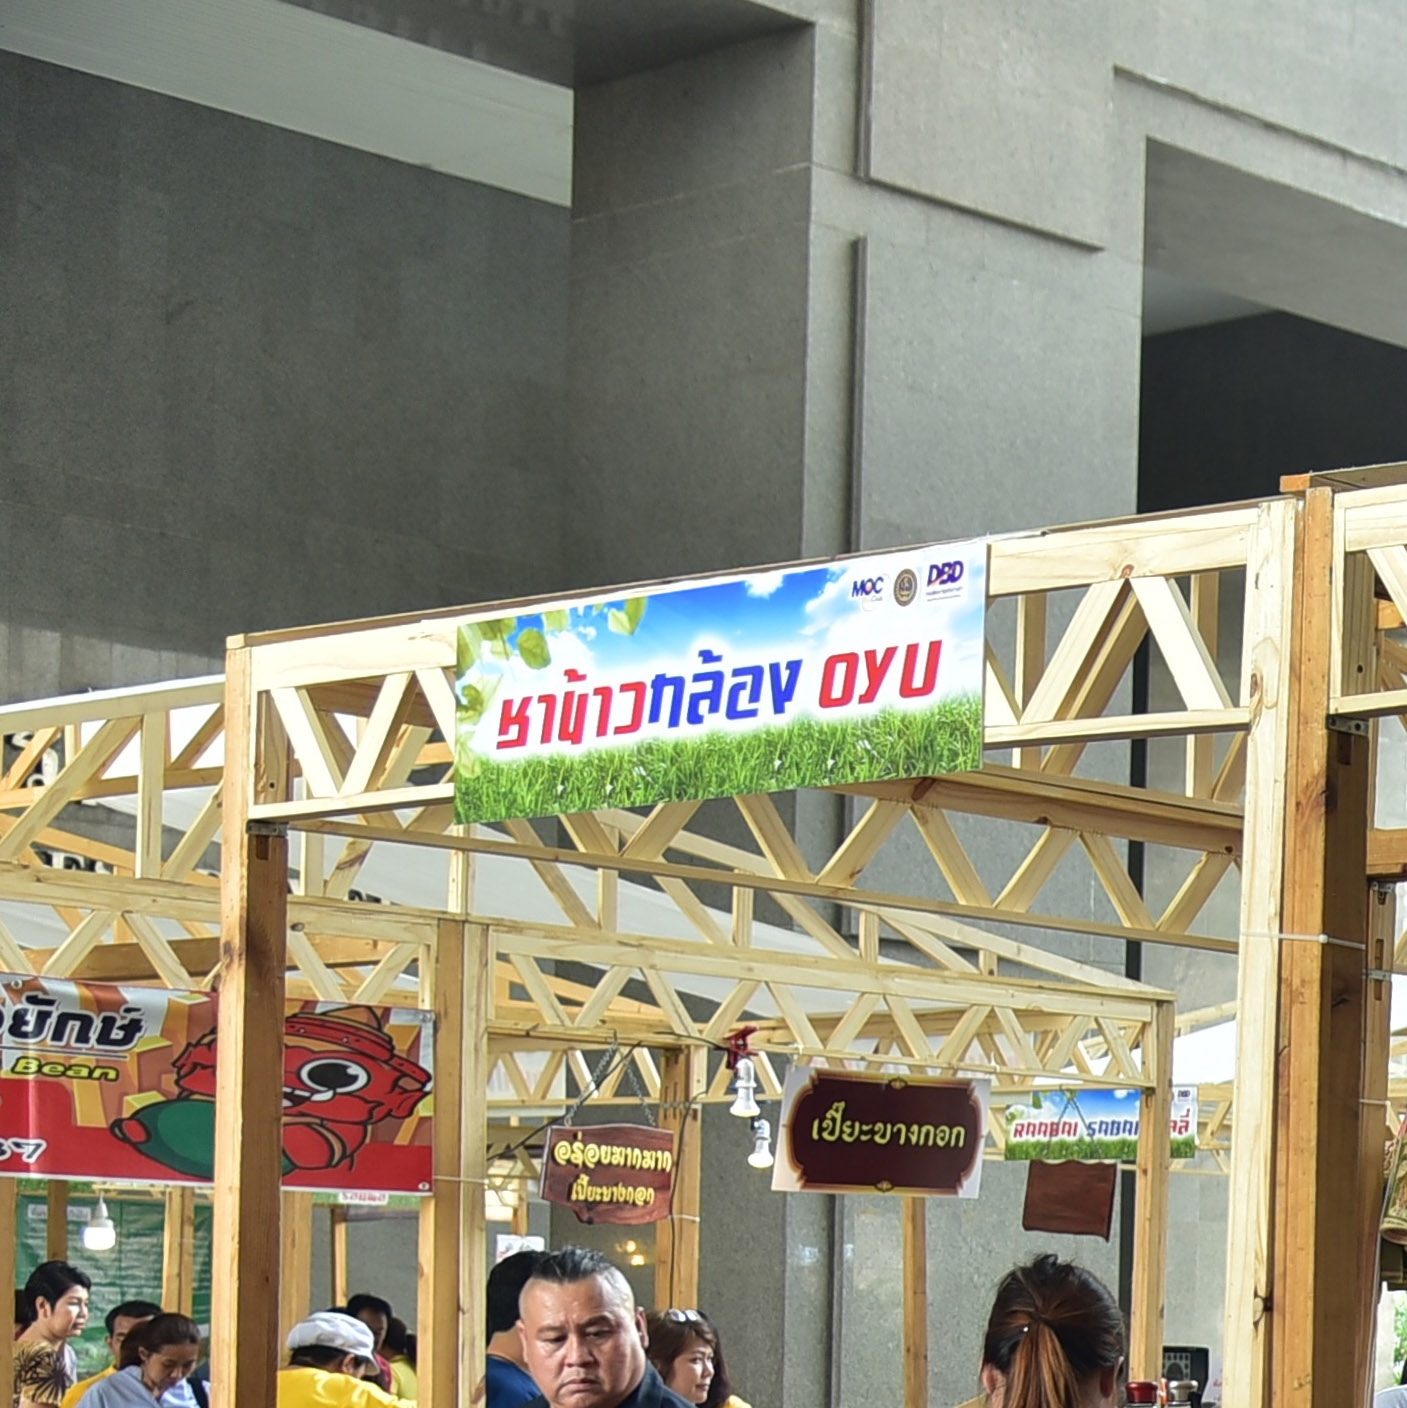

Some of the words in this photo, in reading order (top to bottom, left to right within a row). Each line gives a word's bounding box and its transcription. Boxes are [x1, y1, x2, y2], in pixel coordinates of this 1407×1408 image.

[851, 576, 884, 598] MOC
[926, 560, 964, 587] DBD
[496, 648, 803, 751] ชาข้าวกล้อง
[818, 639, 943, 709] OYU
[0, 993, 145, 1049] ยักษ์
[10, 1056, 120, 1081] Bean
[812, 1101, 966, 1148] เปี๊ยะบางกอก
[554, 1131, 673, 1173] อร่อยมากมาก
